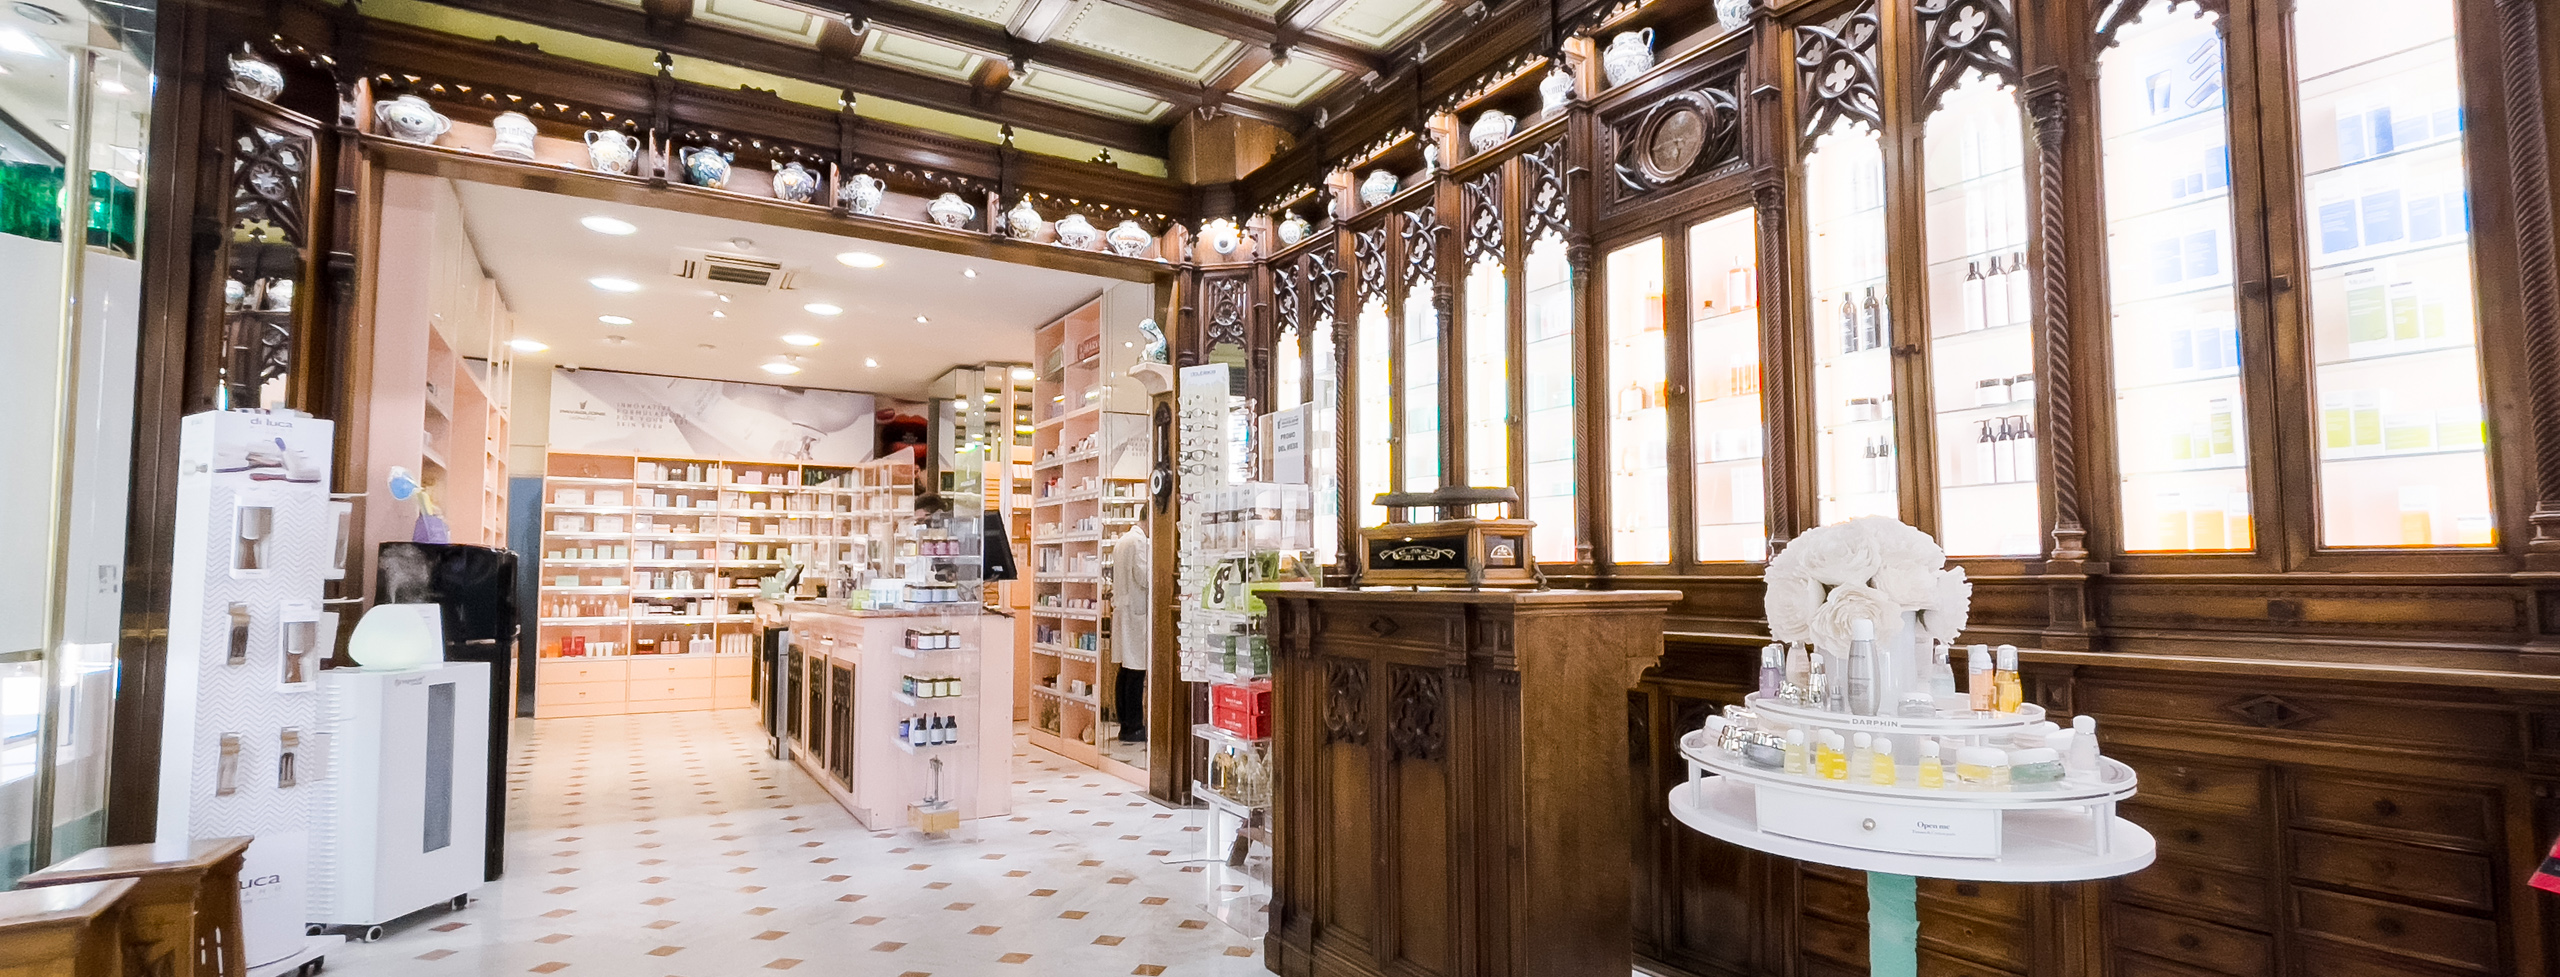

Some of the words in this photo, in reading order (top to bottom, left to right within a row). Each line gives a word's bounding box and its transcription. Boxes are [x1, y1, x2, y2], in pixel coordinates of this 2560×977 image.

[617, 402, 671, 411] INNOVATIVE
[266, 419, 292, 427] luca
[1852, 718, 1898, 727] DARPHIN
[1916, 821, 1938, 830] Open
[240, 874, 280, 889] uca
